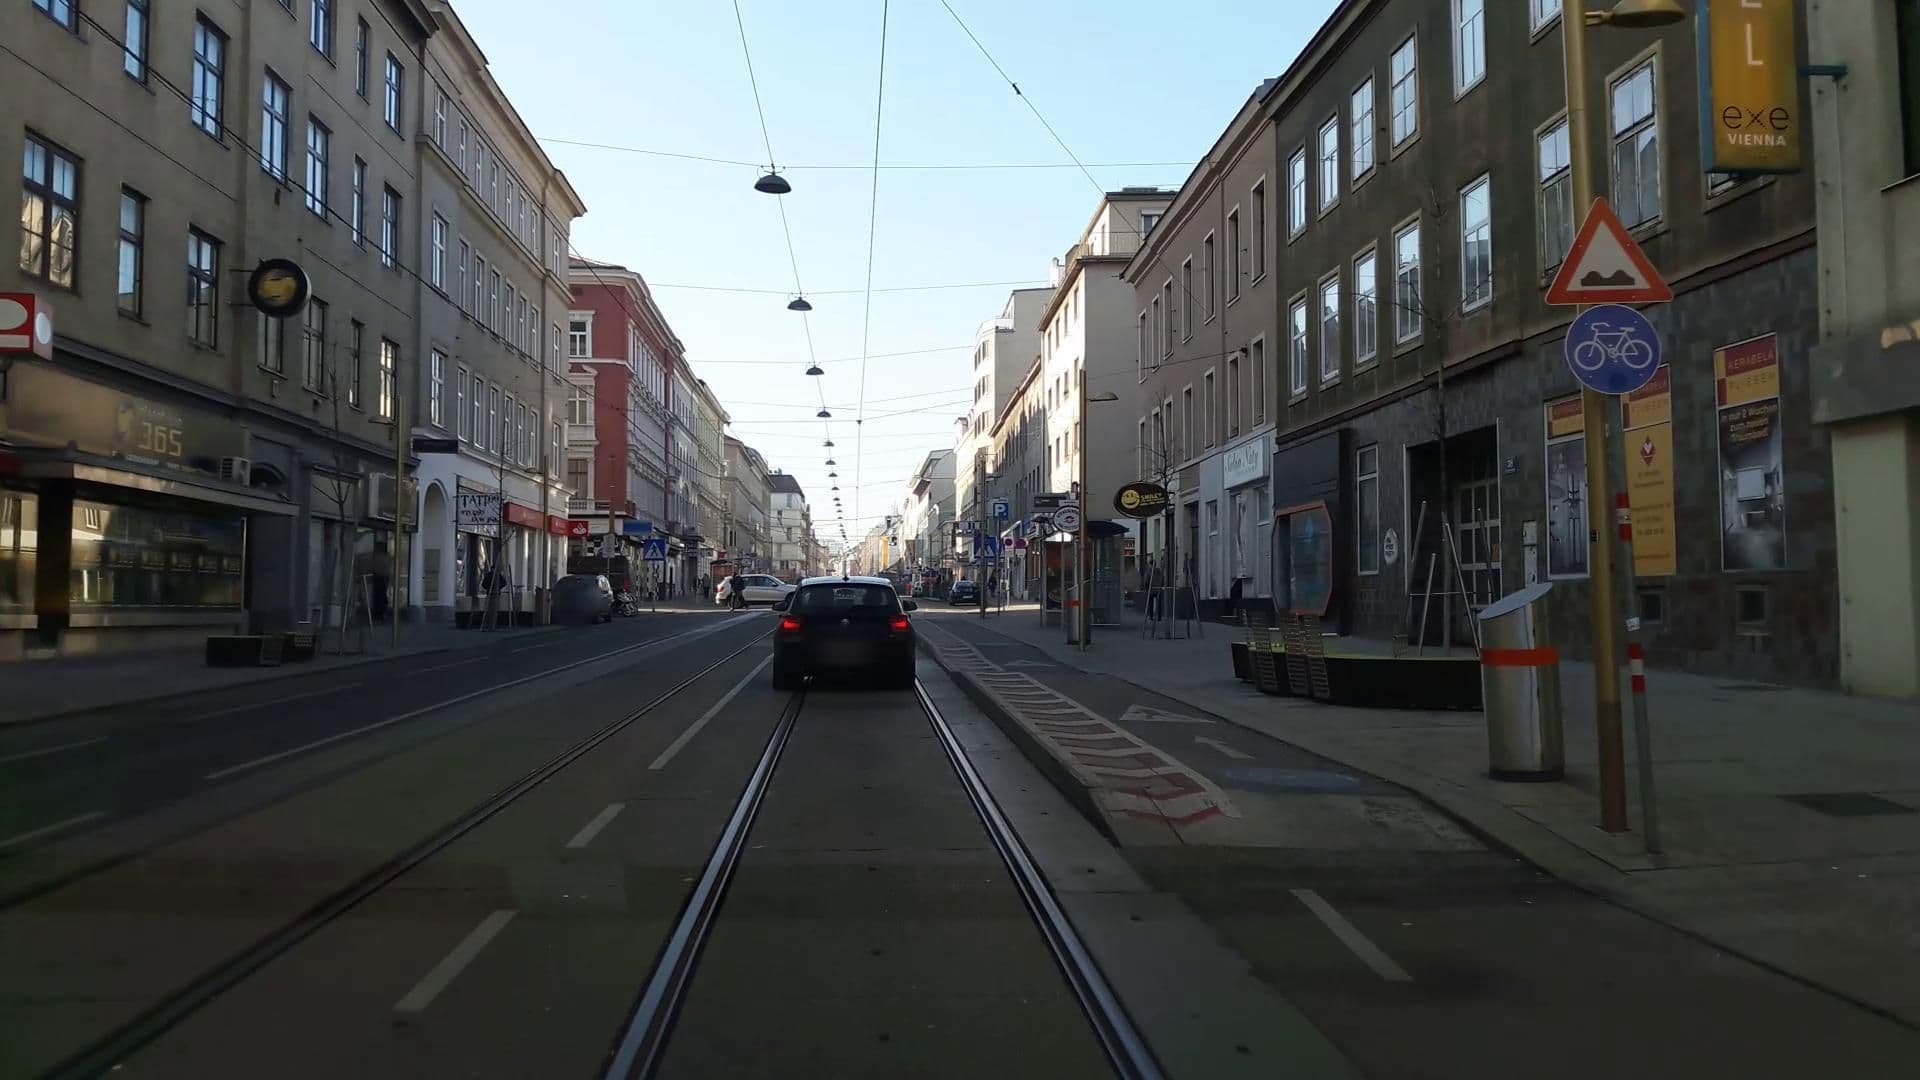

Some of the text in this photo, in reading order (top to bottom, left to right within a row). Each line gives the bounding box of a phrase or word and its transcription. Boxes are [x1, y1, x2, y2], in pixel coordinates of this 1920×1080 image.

[1741, 0, 1764, 66] L
[1722, 105, 1790, 131] exe
[1727, 133, 1787, 147] VIENNA
[137, 422, 182, 457] 365
[460, 495, 500, 508] TATTOO
